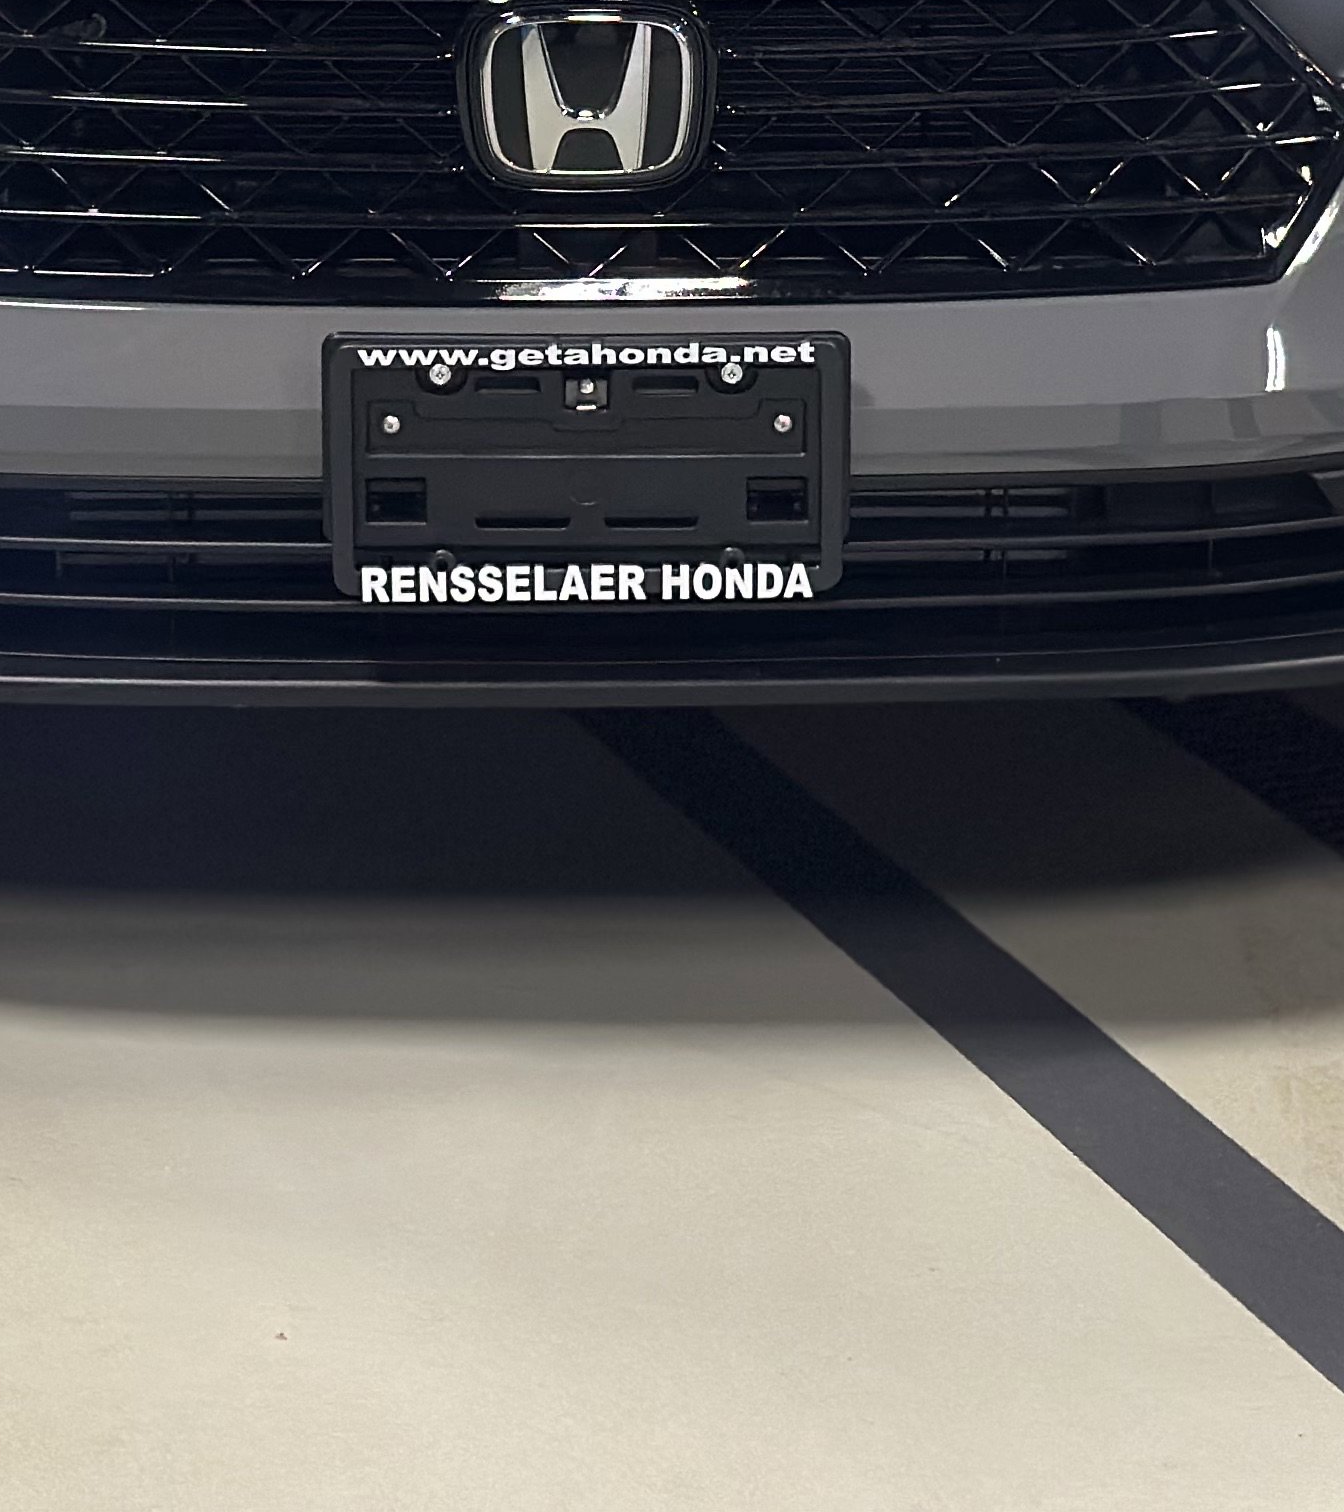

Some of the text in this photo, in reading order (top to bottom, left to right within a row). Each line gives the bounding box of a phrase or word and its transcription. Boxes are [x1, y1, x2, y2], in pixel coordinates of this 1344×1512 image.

[356, 340, 815, 370] www.getahonda.net
[360, 562, 814, 603] RENSSELAER HONDA
